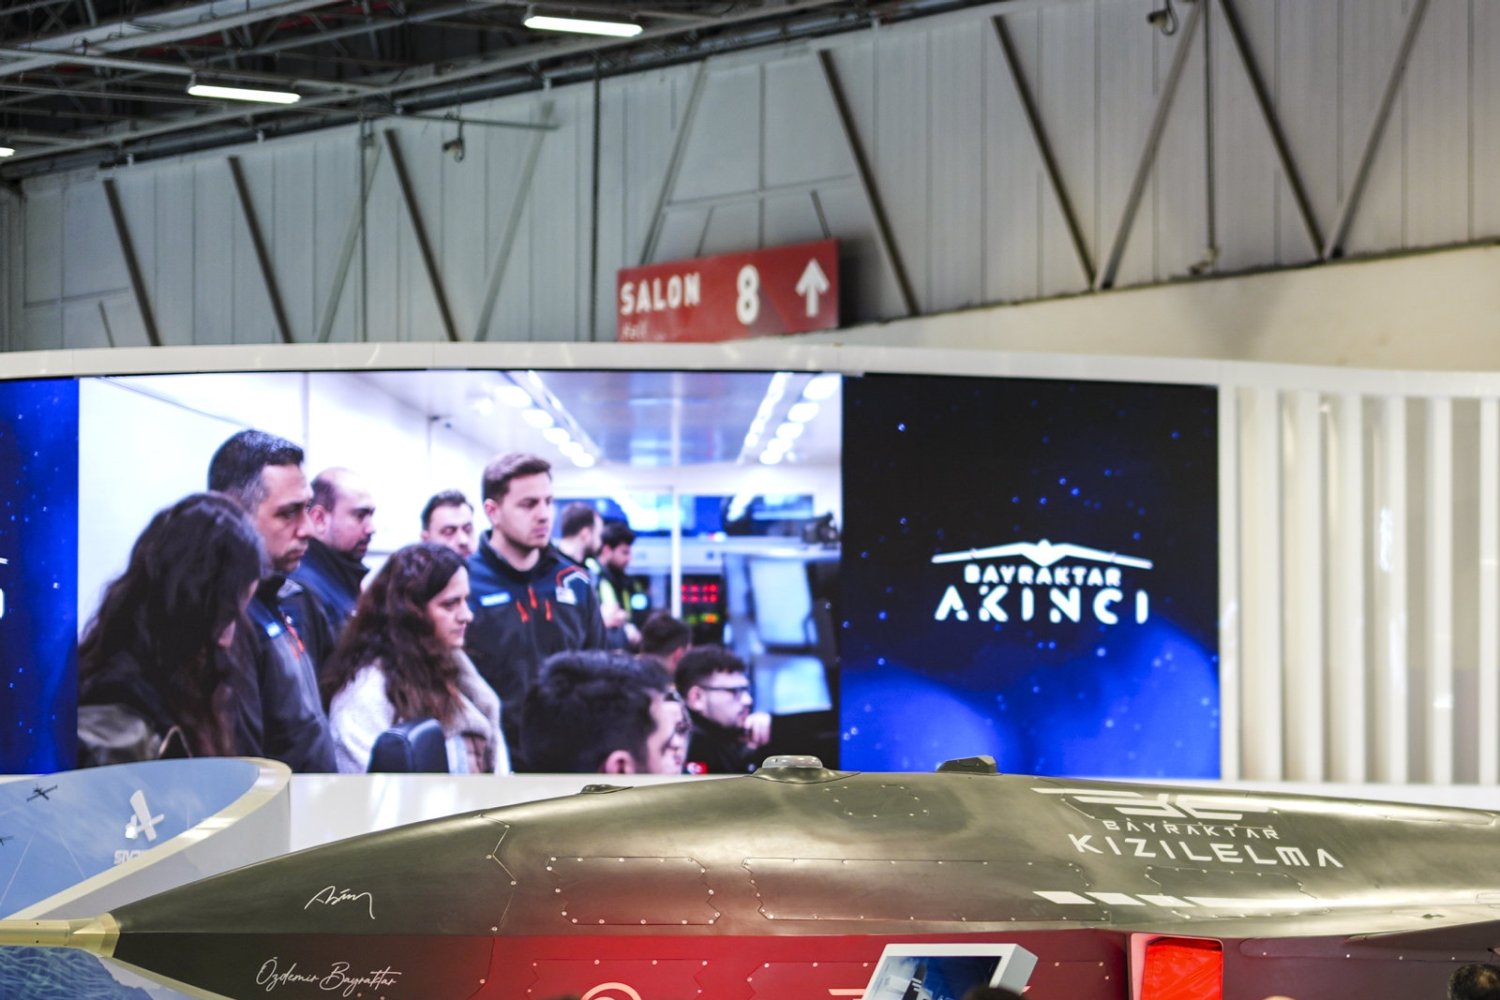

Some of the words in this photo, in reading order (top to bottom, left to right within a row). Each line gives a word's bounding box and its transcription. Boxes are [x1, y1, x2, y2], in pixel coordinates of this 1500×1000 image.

[621, 272, 700, 316] SALON
[736, 264, 759, 325] 8
[964, 564, 1122, 587] BAYRAKTAR
[934, 585, 1149, 625] AKINCI
[1102, 820, 1280, 840] BAYRAKTAR
[1068, 833, 1344, 868] KIZILELMA
[256, 956, 319, 992] Özdemir
[319, 961, 402, 998] Bayraktar
